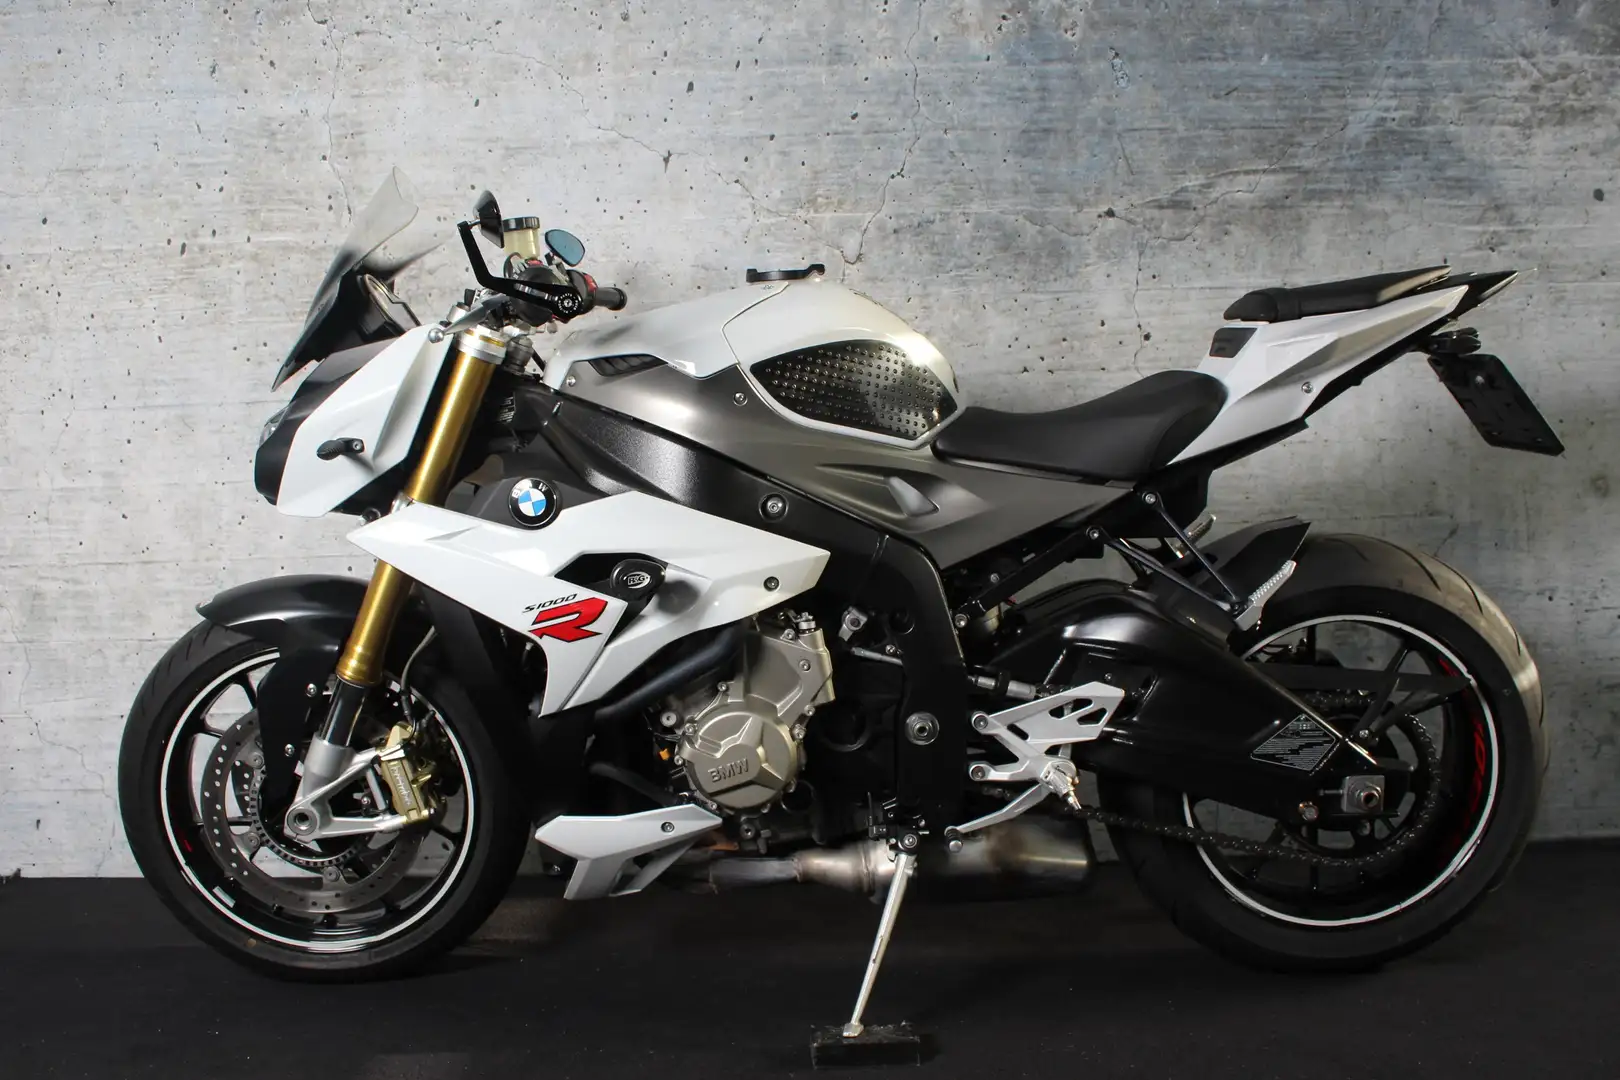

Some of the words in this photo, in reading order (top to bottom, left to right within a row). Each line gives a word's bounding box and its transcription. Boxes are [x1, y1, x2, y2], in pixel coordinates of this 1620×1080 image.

[628, 574, 648, 586] R&G
[523, 593, 578, 613] S1000
[528, 597, 608, 643] R
[707, 757, 749, 783] BMW
